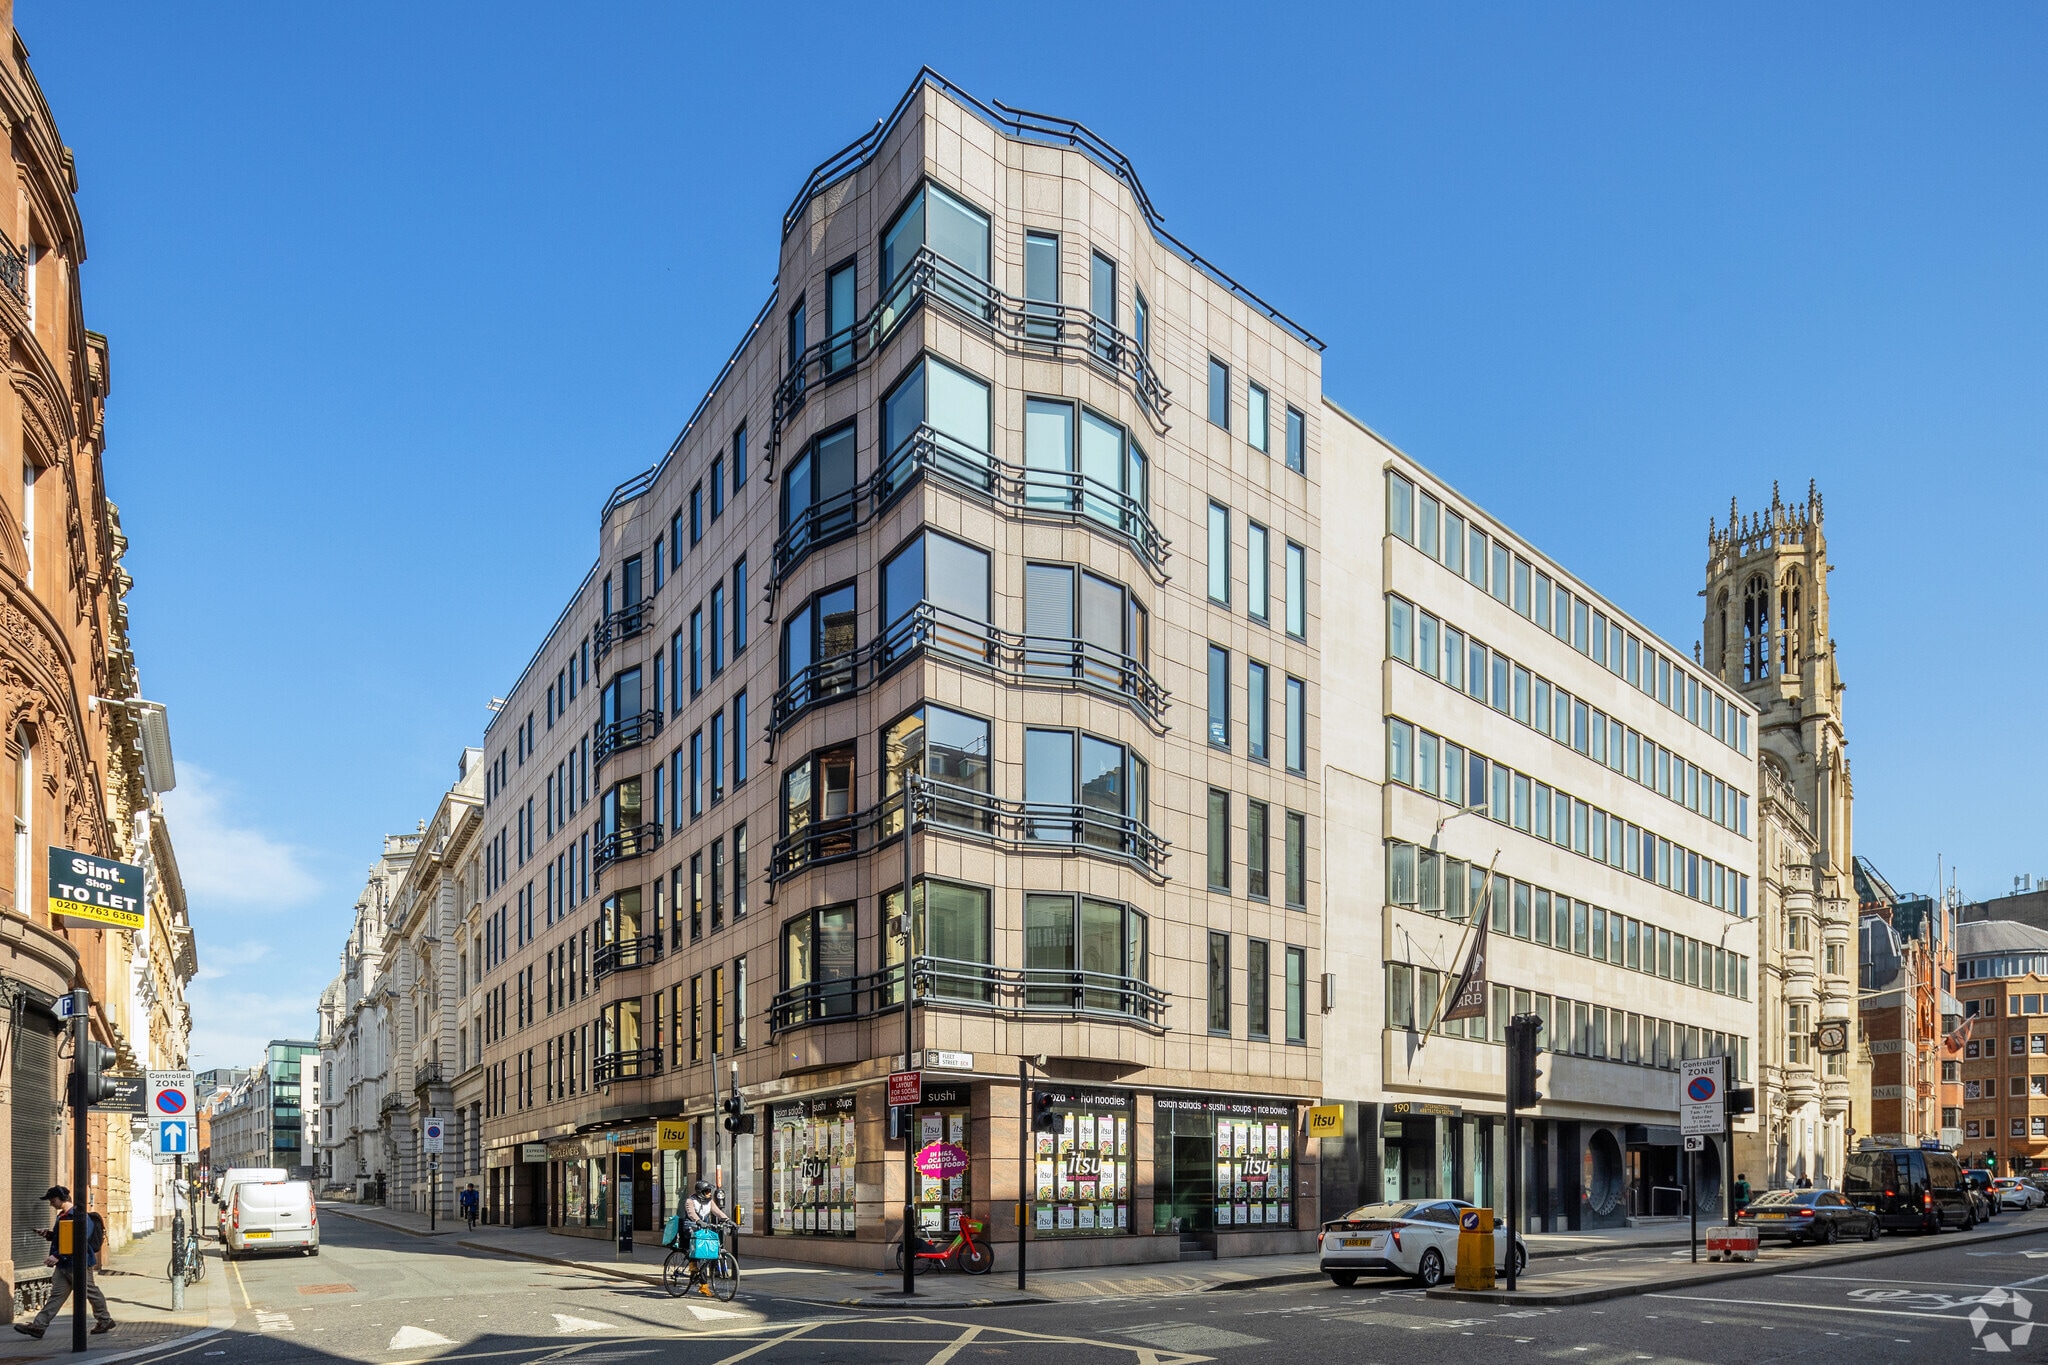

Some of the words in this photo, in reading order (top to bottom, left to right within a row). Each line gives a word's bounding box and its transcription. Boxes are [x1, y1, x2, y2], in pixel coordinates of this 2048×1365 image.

[86, 878, 112, 892] Shop
[58, 884, 90, 902] TO
[97, 892, 137, 911] LET
[56, 900, 78, 910] 020
[82, 905, 109, 916] 7763
[113, 911, 138, 922] 6363
[64, 1000, 71, 1014] P
[1457, 993, 1482, 1008] ARB
[1683, 1060, 1720, 1068] Controlled
[1688, 1067, 1714, 1076] ZONE
[928, 1090, 956, 1101] sushi
[1095, 1095, 1125, 1106] noodles
[813, 1101, 826, 1112] sushi
[1158, 1100, 1177, 1108] asian
[1178, 1100, 1201, 1110] salads
[1208, 1102, 1226, 1111] sushi
[1232, 1104, 1251, 1115] soups
[1258, 1105, 1269, 1114] rice
[1270, 1106, 1287, 1115] bowls
[1394, 1103, 1410, 1113] 190
[1313, 1114, 1335, 1127] itsu
[663, 1128, 685, 1140] itsu
[1068, 1151, 1102, 1174] itsu
[1243, 1155, 1270, 1174] itsu
[1040, 1217, 1051, 1225] itsu
